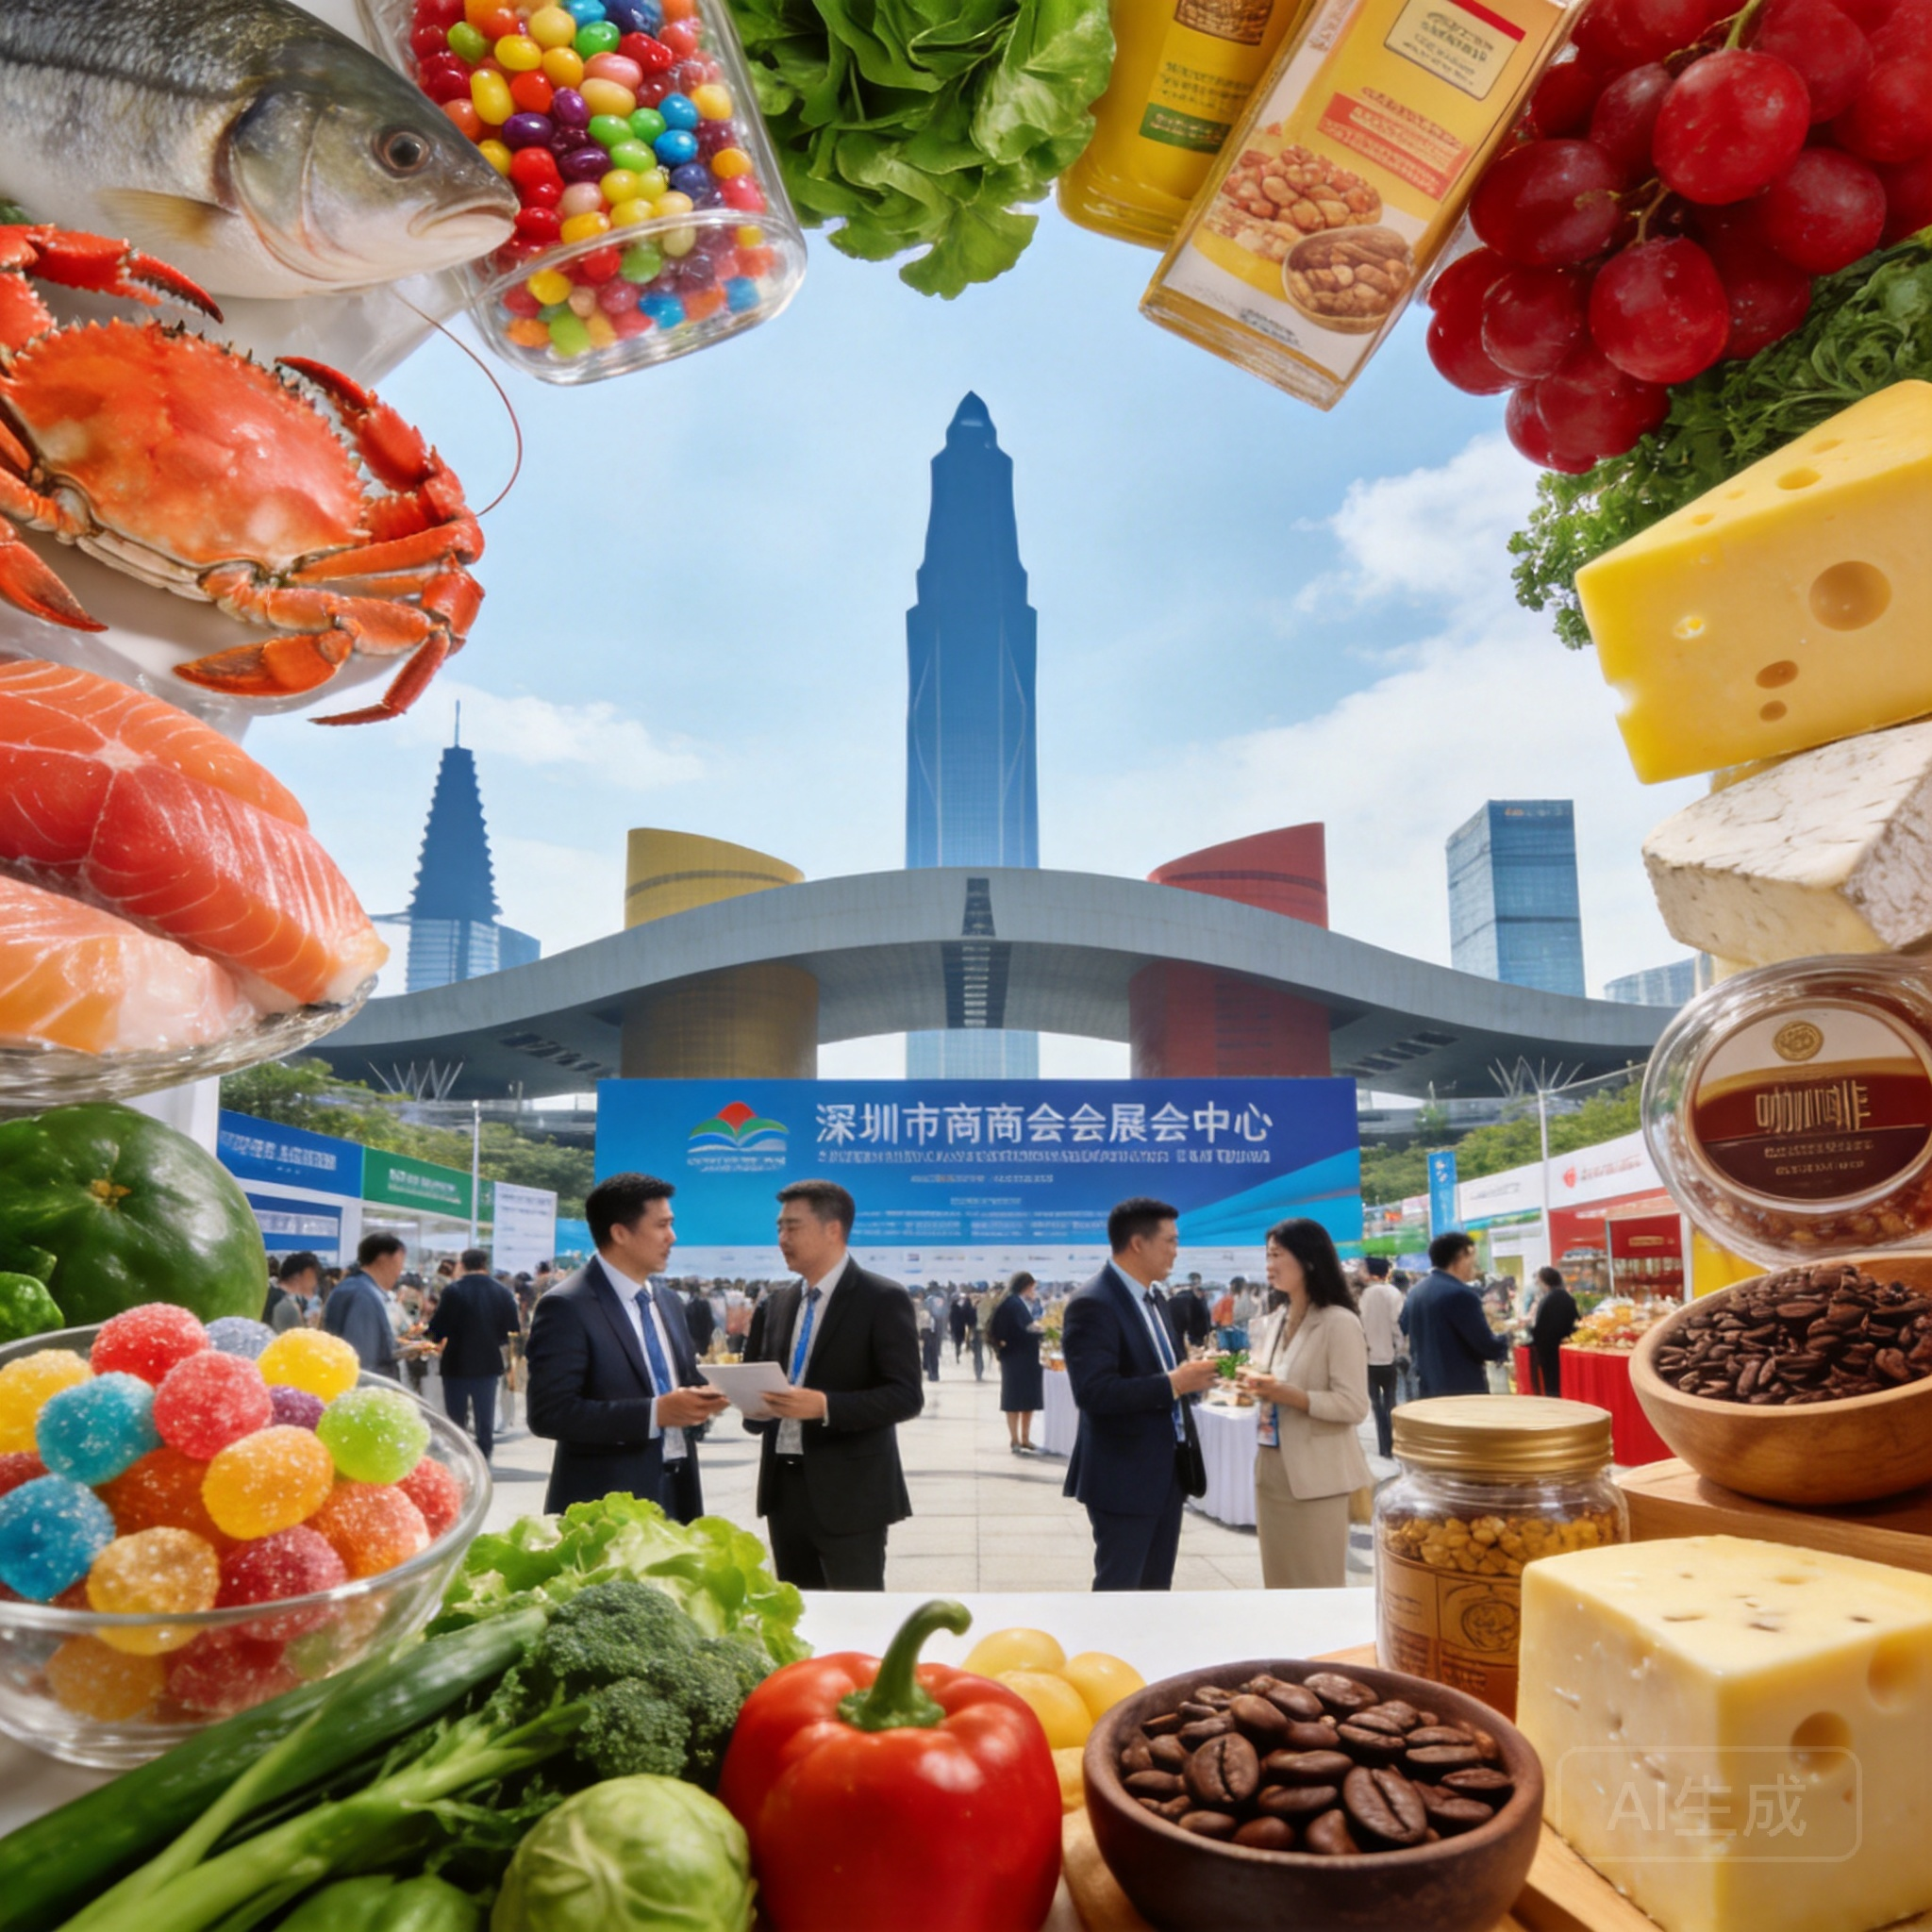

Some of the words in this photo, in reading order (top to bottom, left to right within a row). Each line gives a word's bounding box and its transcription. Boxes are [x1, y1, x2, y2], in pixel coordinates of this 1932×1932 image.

[816, 1102, 1274, 1145] 深圳市商商会会展会中心
